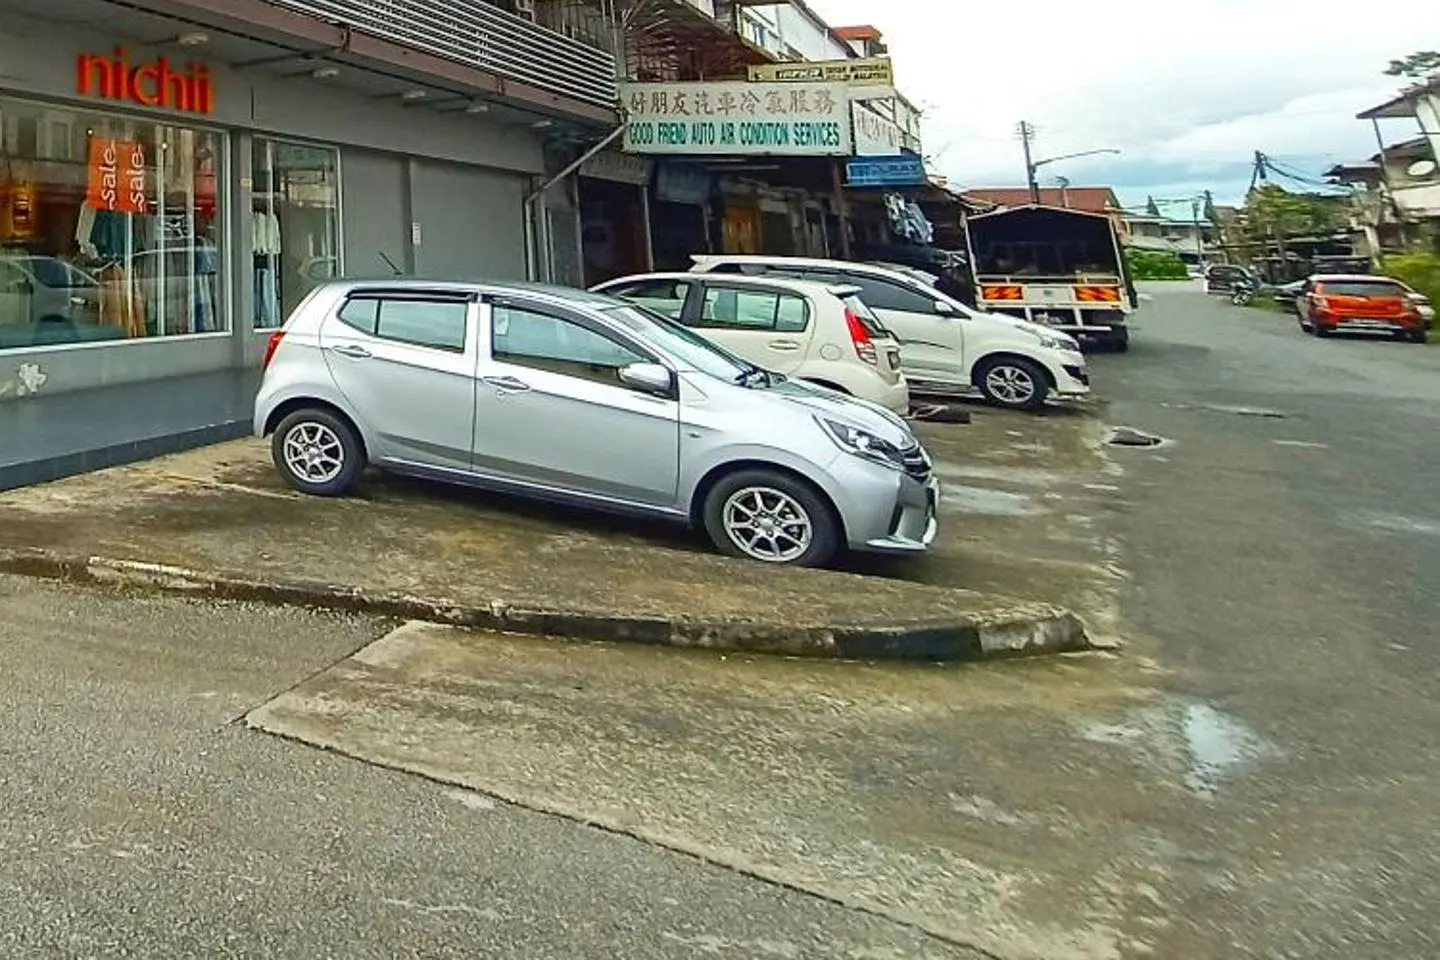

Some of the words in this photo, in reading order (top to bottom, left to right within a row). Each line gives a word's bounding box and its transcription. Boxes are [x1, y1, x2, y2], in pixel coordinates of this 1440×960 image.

[76, 45, 217, 114] nichii
[628, 121, 654, 145] GOOD
[657, 121, 687, 146] FRIEND
[691, 121, 716, 146] AUTO
[719, 121, 736, 146] AIR
[740, 121, 789, 146] CONDITION
[793, 121, 840, 147] SERVICES
[98, 144, 117, 206] sale
[126, 148, 146, 208] sale
